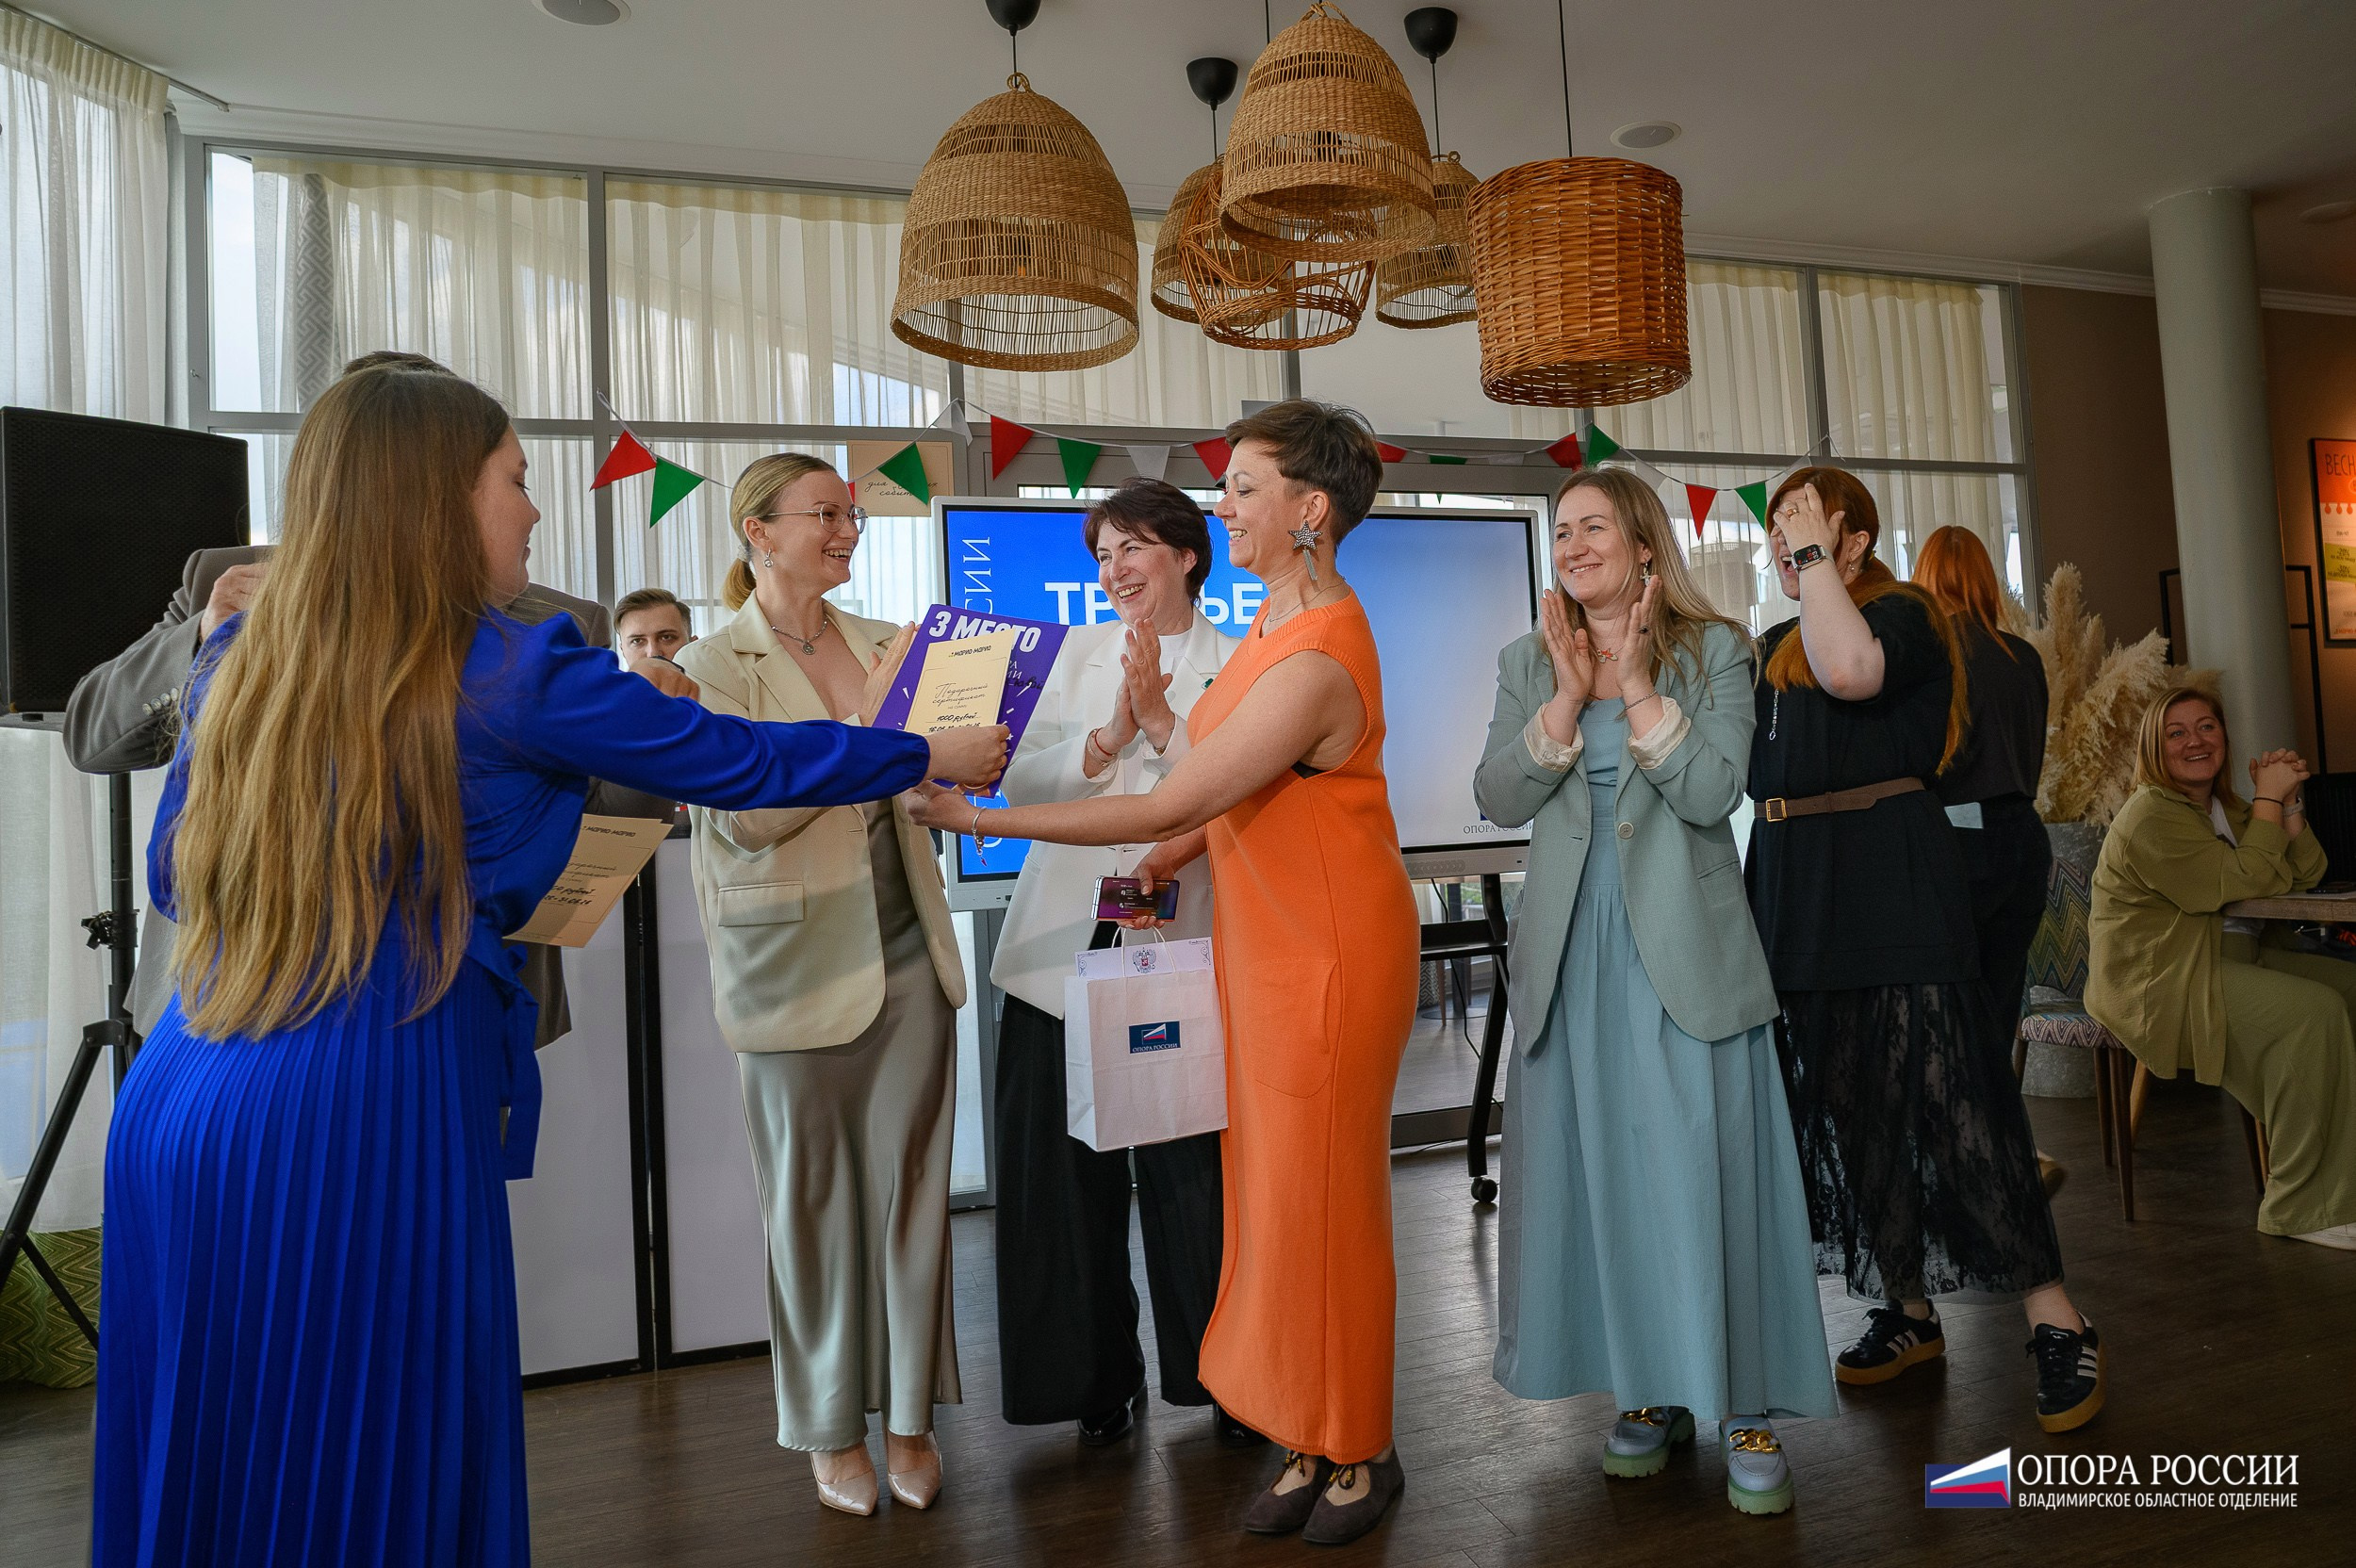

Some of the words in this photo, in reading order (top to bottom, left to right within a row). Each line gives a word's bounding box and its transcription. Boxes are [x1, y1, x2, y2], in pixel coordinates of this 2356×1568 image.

[2325, 453, 2356, 476] ВЕСН
[1044, 581, 1264, 626] ТРЬЕ
[928, 611, 952, 638] 3
[1463, 825, 1497, 835] ОПОРА
[1153, 1042, 1178, 1051] РОССИИ
